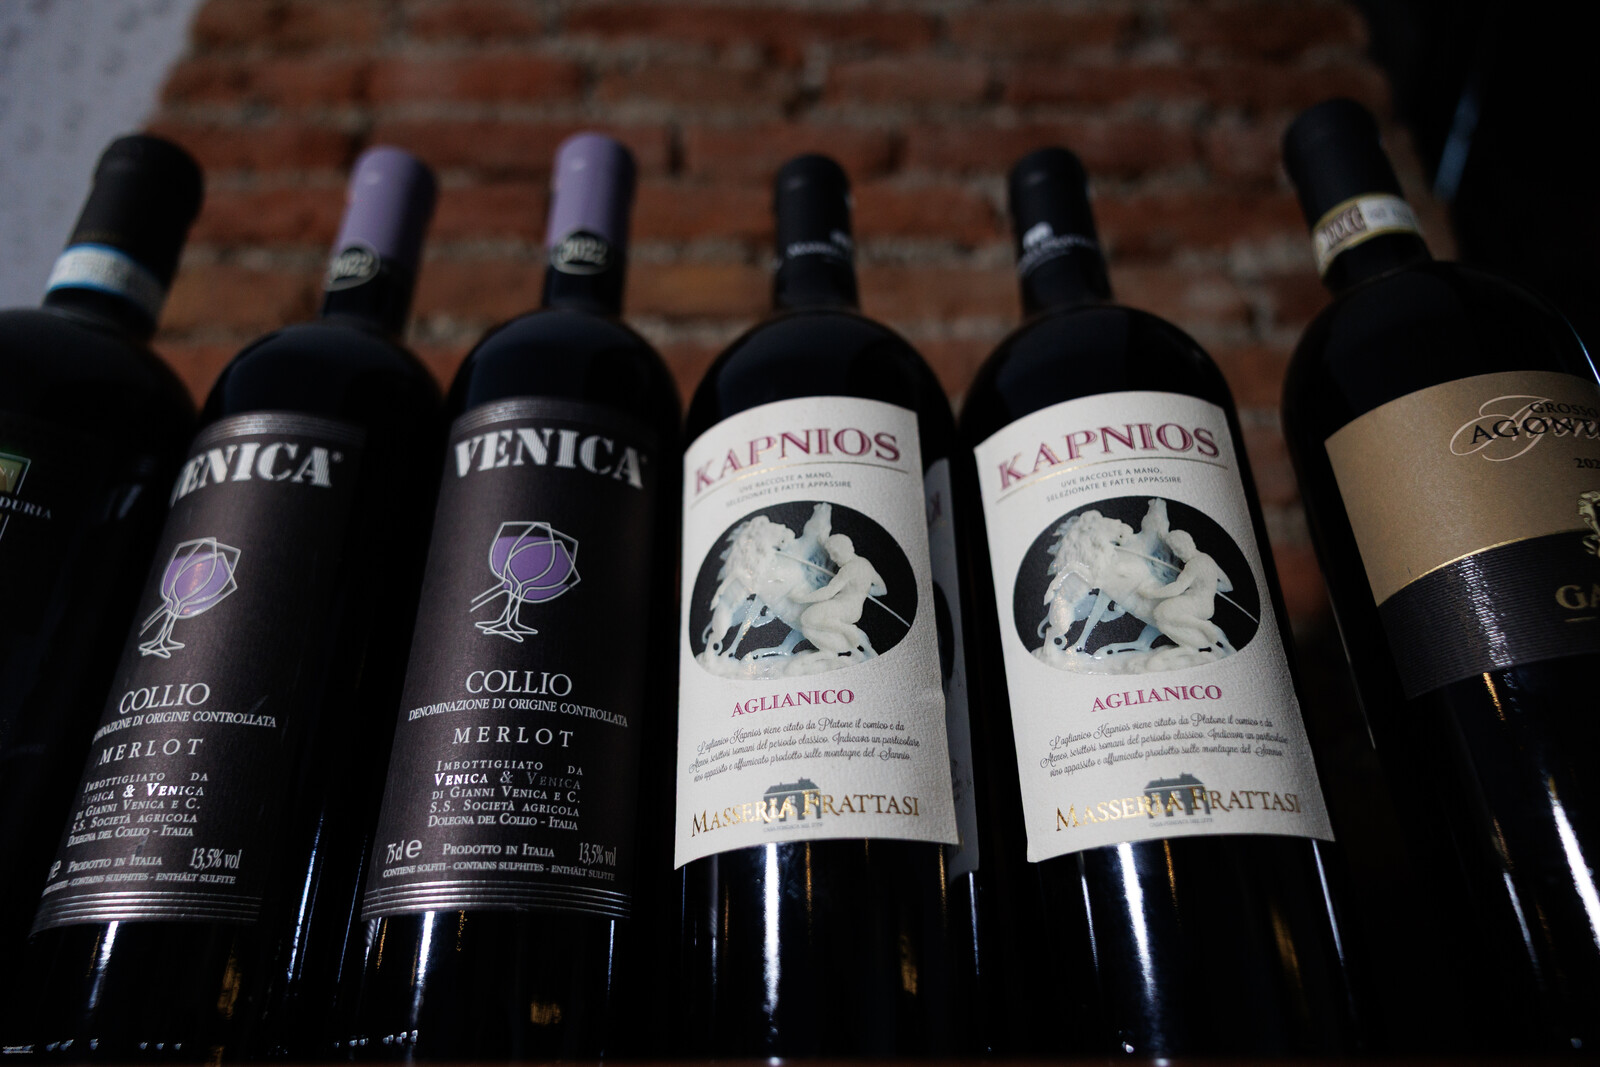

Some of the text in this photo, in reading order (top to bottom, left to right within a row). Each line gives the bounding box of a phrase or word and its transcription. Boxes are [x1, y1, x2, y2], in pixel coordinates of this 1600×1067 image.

[1530, 402, 1599, 416] GROSSO
[694, 427, 900, 496] KAPNIOS
[998, 422, 1221, 490] KAPNIOS
[170, 442, 331, 508] ENICA
[756, 475, 794, 487] RACCOLTE
[1061, 479, 1077, 488] UVE
[1080, 469, 1122, 482] RACCOLTE
[781, 483, 805, 492] FATTE
[1046, 476, 1182, 502] SELEZIONATE E FATTE APPASSIRE
[466, 670, 572, 696] COLLIO
[119, 682, 210, 715] COLLIO
[731, 689, 855, 718] AGLIANICO
[1090, 684, 1222, 712] AGLIANICO
[132, 710, 277, 728] DI ORIGINE CONTROLLATA
[408, 698, 628, 728] DENOMINAZIONE DI ORIGINE CONTROLLATA
[783, 721, 804, 732] citato
[806, 720, 816, 730] da
[818, 717, 853, 732] Platone
[855, 718, 862, 728] il
[863, 720, 888, 730] comico
[896, 721, 905, 731] da
[1093, 722, 1130, 740] Kapnios
[1132, 720, 1152, 730] viene
[1154, 716, 1177, 728] citato
[1178, 714, 1190, 725] da
[1190, 712, 1226, 727] Platone
[1227, 714, 1234, 725] il
[452, 726, 574, 748] MERLOT
[756, 738, 768, 750] del
[768, 735, 797, 752] periodo
[872, 736, 880, 744] un
[882, 736, 920, 748] particolare
[1098, 737, 1126, 750] romani
[1126, 734, 1140, 746] del
[1140, 730, 1172, 747] periodo
[98, 738, 204, 766] MERLOT
[769, 750, 802, 766] prodotto
[803, 748, 822, 759] sulle
[824, 748, 860, 760] montagne
[863, 747, 876, 758] del
[1064, 758, 1096, 776] appassito
[1096, 758, 1102, 766] e
[1102, 750, 1144, 766] affumicato
[1144, 745, 1180, 761] prodotto
[1181, 743, 1200, 754] sulle
[1202, 744, 1239, 757] montagne
[1240, 744, 1252, 754] del
[190, 772, 208, 782] DA
[436, 760, 584, 776] IMBOTTIGLIATO DA
[434, 772, 489, 786] VENICA
[500, 770, 514, 784] &
[122, 784, 136, 798] &
[146, 782, 204, 796] VENICA
[432, 786, 581, 804] DI GIANNI VENICA E C.
[86, 803, 118, 817] GIANNI
[123, 799, 164, 810] VENICA
[171, 800, 178, 809] E
[185, 798, 200, 810] C.
[430, 800, 456, 814] S.S.
[522, 803, 580, 818] AGRICOLA
[1190, 786, 1302, 814] FRATTASI
[136, 813, 198, 823] AGRICOLA
[427, 812, 579, 831] DOLEGNA DEL COLLIO ITALIA
[691, 790, 920, 837] MASSERIA FRATTASI
[97, 829, 112, 840] DEL
[114, 826, 150, 838] COLLIO
[160, 824, 194, 837] ITALIA
[66, 848, 242, 874] PRODOTTO IN ITALIA 13,5% vol
[442, 843, 502, 856] PRODOTTO
[505, 845, 518, 855] IN
[522, 842, 556, 858] ITALIA
[578, 842, 604, 866] 13,5%
[604, 846, 617, 866] vol
[104, 872, 149, 882] SULPHITES
[156, 872, 198, 882] ENTHÄLT
[200, 874, 236, 884] SULFITE
[382, 861, 616, 881] CONTIENE SOLFITI CONTAINS SULPHITES ENTHÄLT SULFITE
